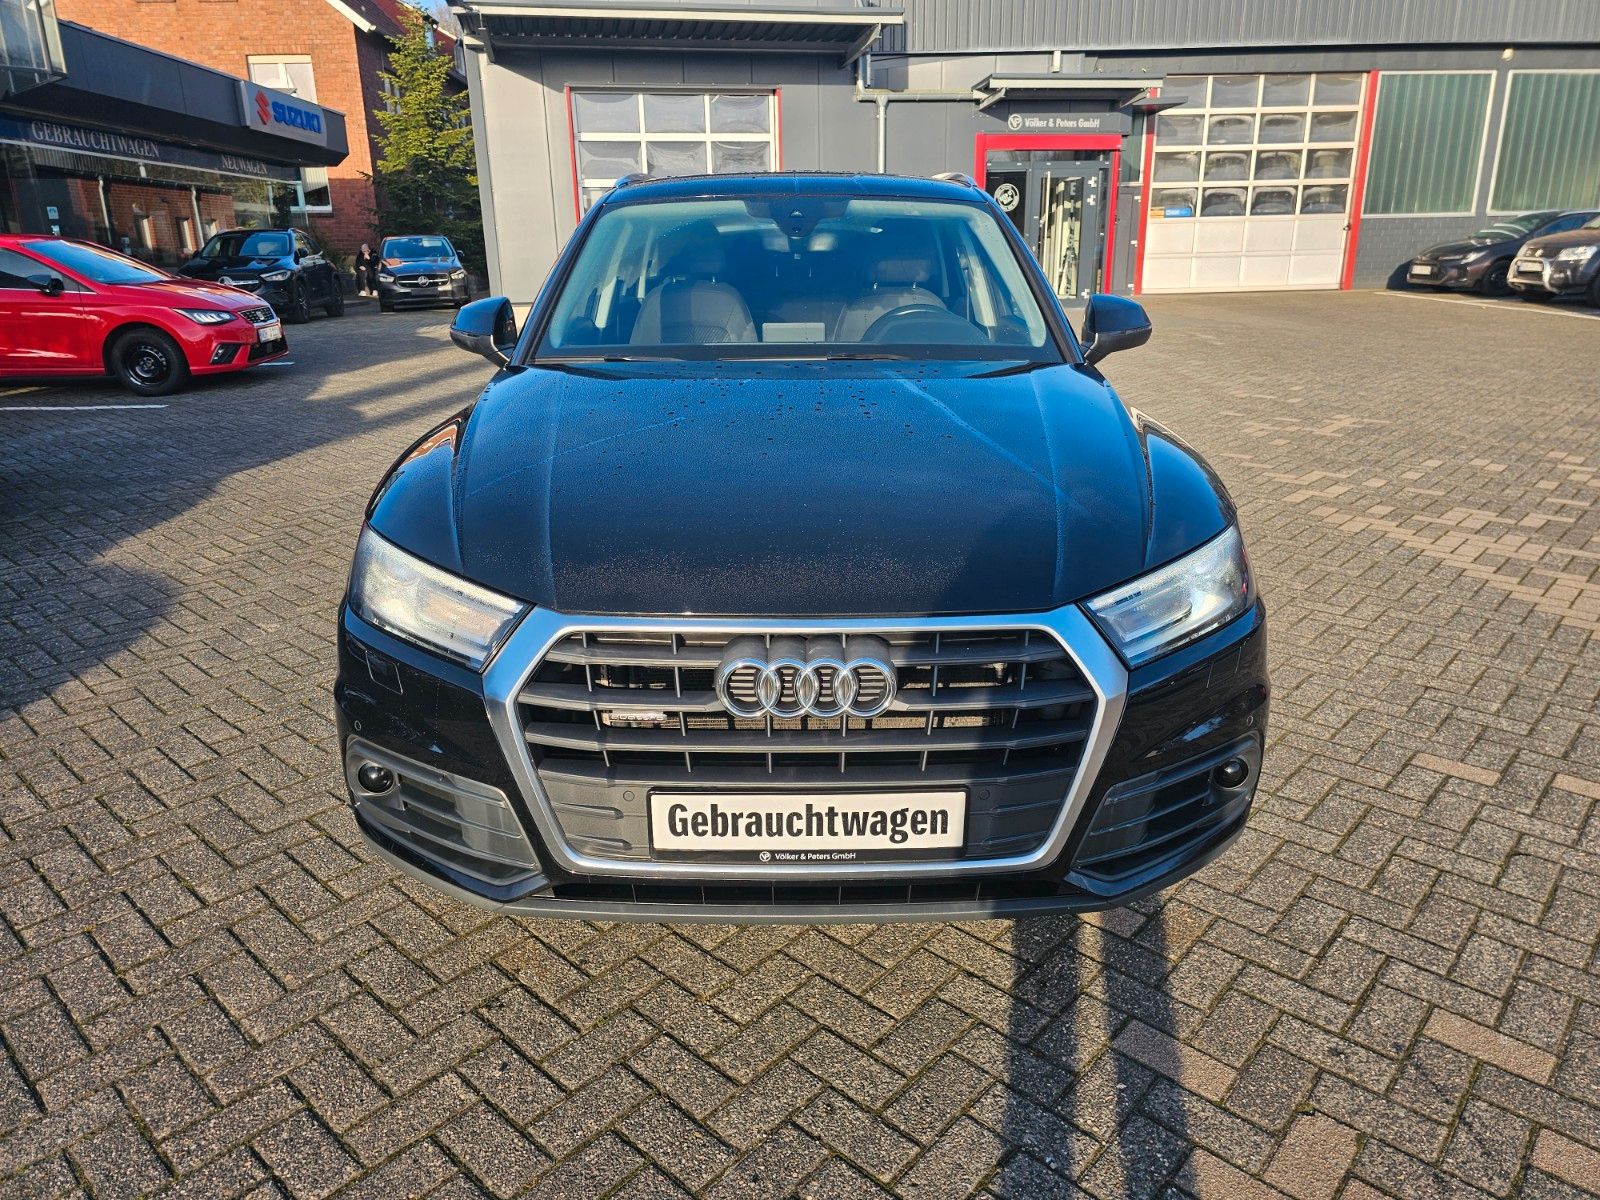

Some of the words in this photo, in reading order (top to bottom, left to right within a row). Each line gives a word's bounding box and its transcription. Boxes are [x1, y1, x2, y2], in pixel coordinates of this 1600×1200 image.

[271, 101, 322, 134] SUZUKI
[1024, 117, 1047, 128] Völker
[1048, 118, 1055, 128] &
[1056, 118, 1077, 128] Peters
[1078, 118, 1100, 128] GmbH
[31, 121, 160, 157] GEBRAUCHTWAGEN
[221, 154, 268, 175] NEUWAGEN
[667, 803, 949, 844] Gebrauchtwagen
[775, 852, 799, 860] Völker
[800, 852, 807, 860] &
[807, 852, 830, 860] Peters
[831, 852, 856, 860] GmbH
